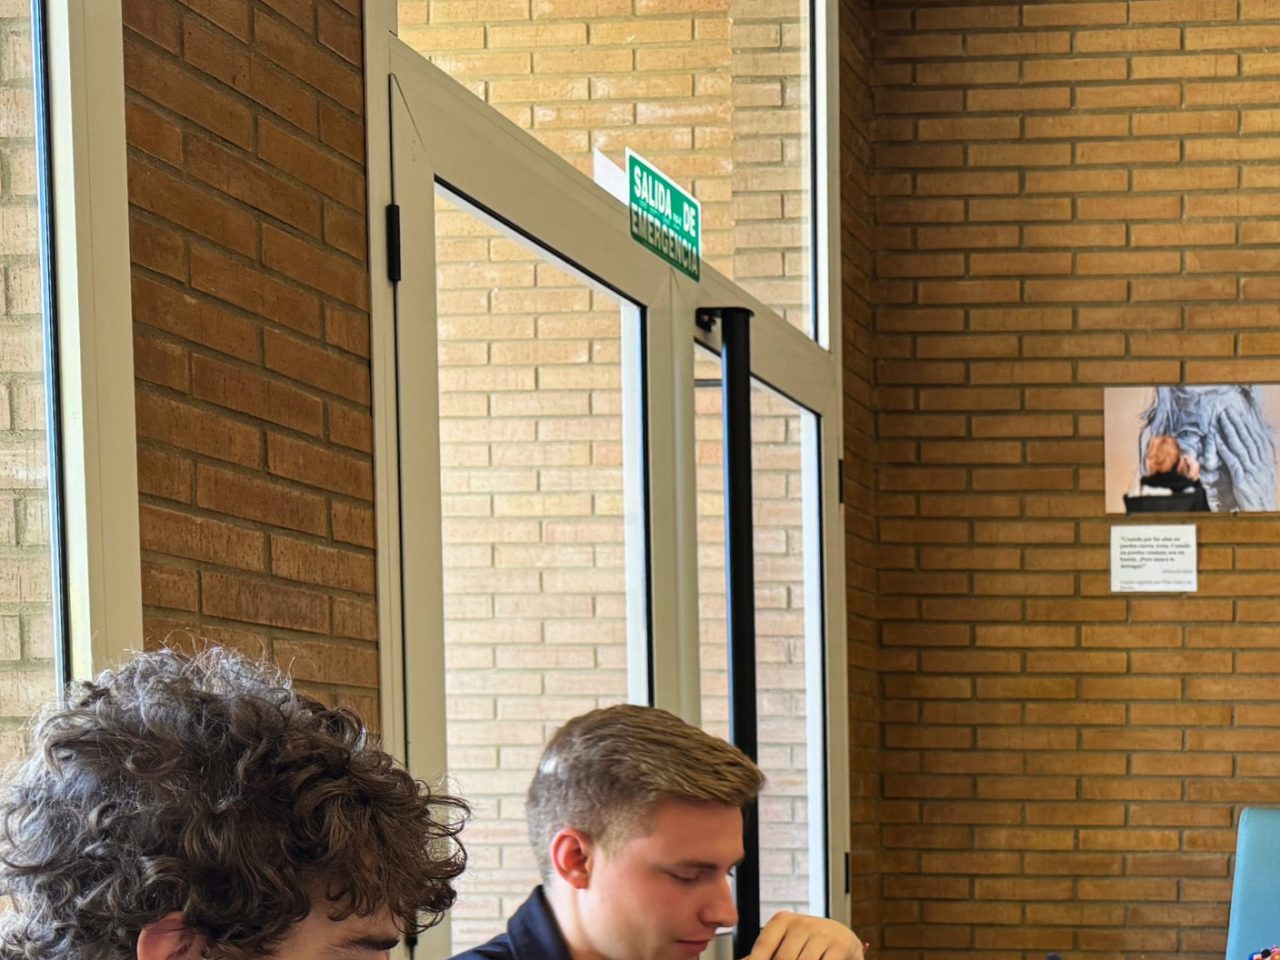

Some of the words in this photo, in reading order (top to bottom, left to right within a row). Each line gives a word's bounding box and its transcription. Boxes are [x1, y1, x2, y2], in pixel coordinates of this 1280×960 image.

[633, 165, 672, 219] SALIDA
[682, 202, 697, 238] DE
[631, 203, 698, 274] EMERGENCIA
